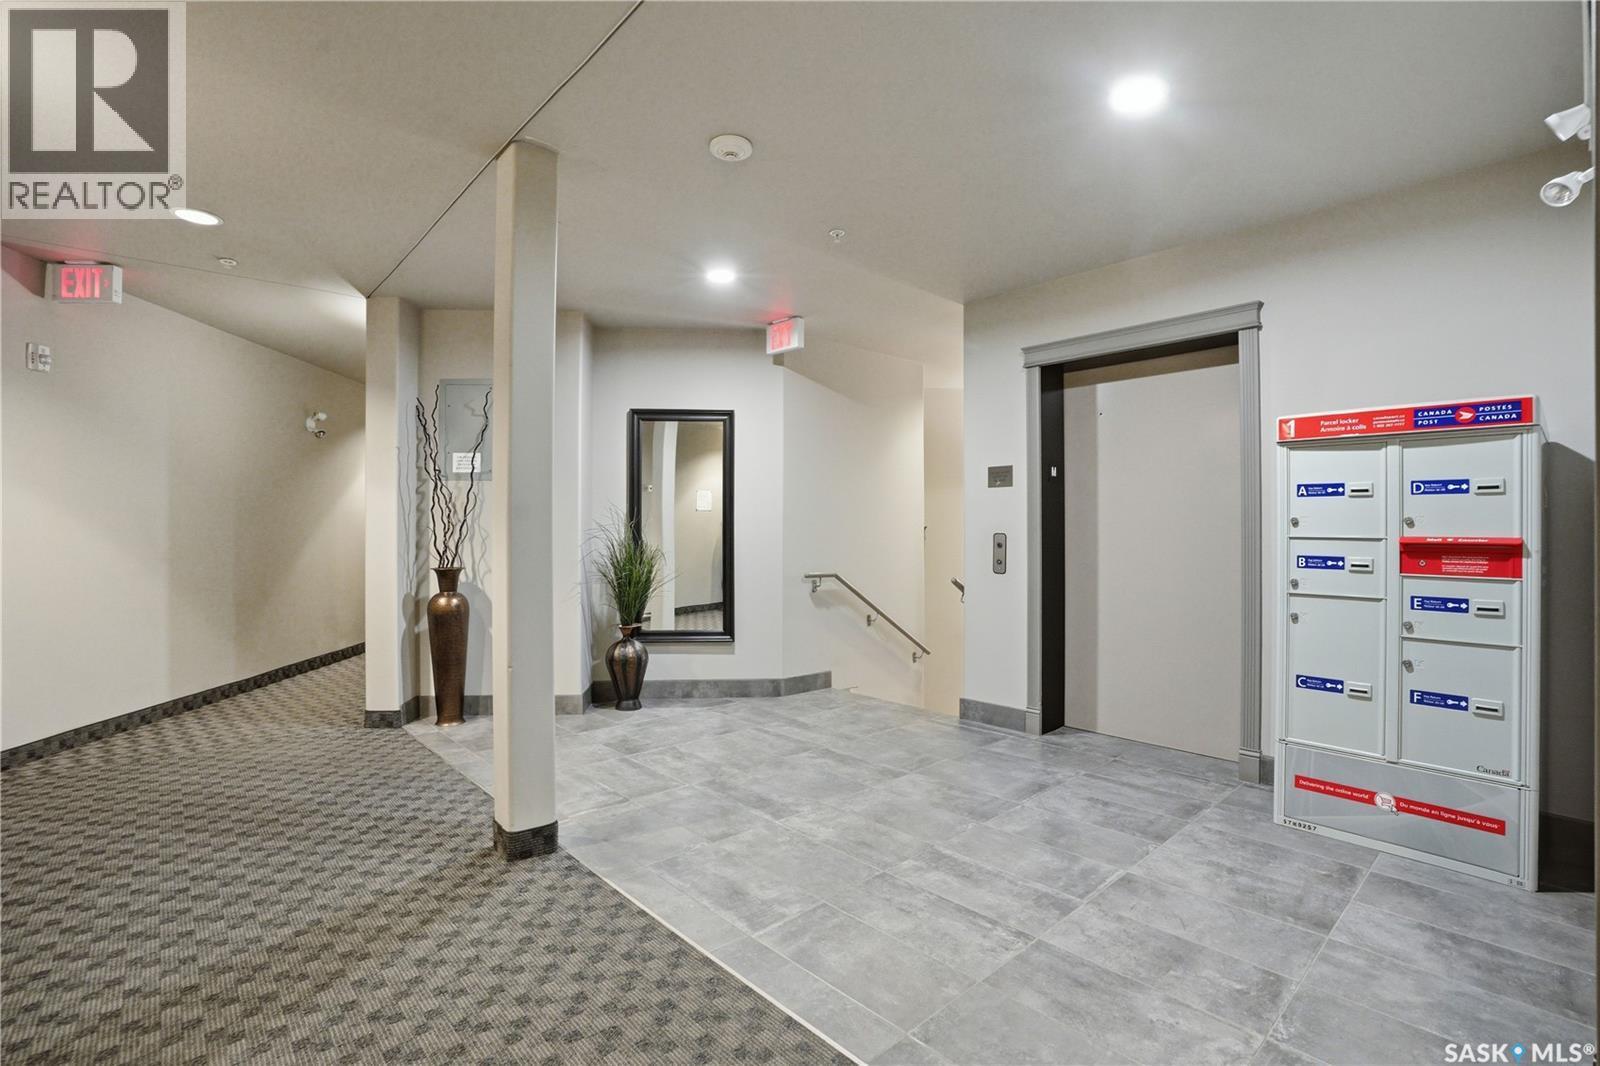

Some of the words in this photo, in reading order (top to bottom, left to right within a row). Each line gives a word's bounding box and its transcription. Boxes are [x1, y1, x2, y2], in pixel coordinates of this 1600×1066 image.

[61, 267, 102, 298] EXIT
[1418, 409, 1452, 417] CANADA
[1479, 413, 1517, 421] CANADA
[1321, 418, 1338, 426] Parcel
[1340, 417, 1359, 425] locker
[1298, 486, 1307, 496] A
[1413, 482, 1424, 493] D
[1298, 557, 1306, 567] B
[1413, 598, 1422, 609] E
[1297, 677, 1306, 687] C
[1413, 692, 1422, 702] F
[1477, 765, 1510, 777] Canada
[1299, 779, 1324, 790] Delivering
[1335, 787, 1351, 795] online
[1353, 791, 1369, 799] world
[1409, 805, 1430, 813] monde
[1440, 811, 1456, 819] ligne
